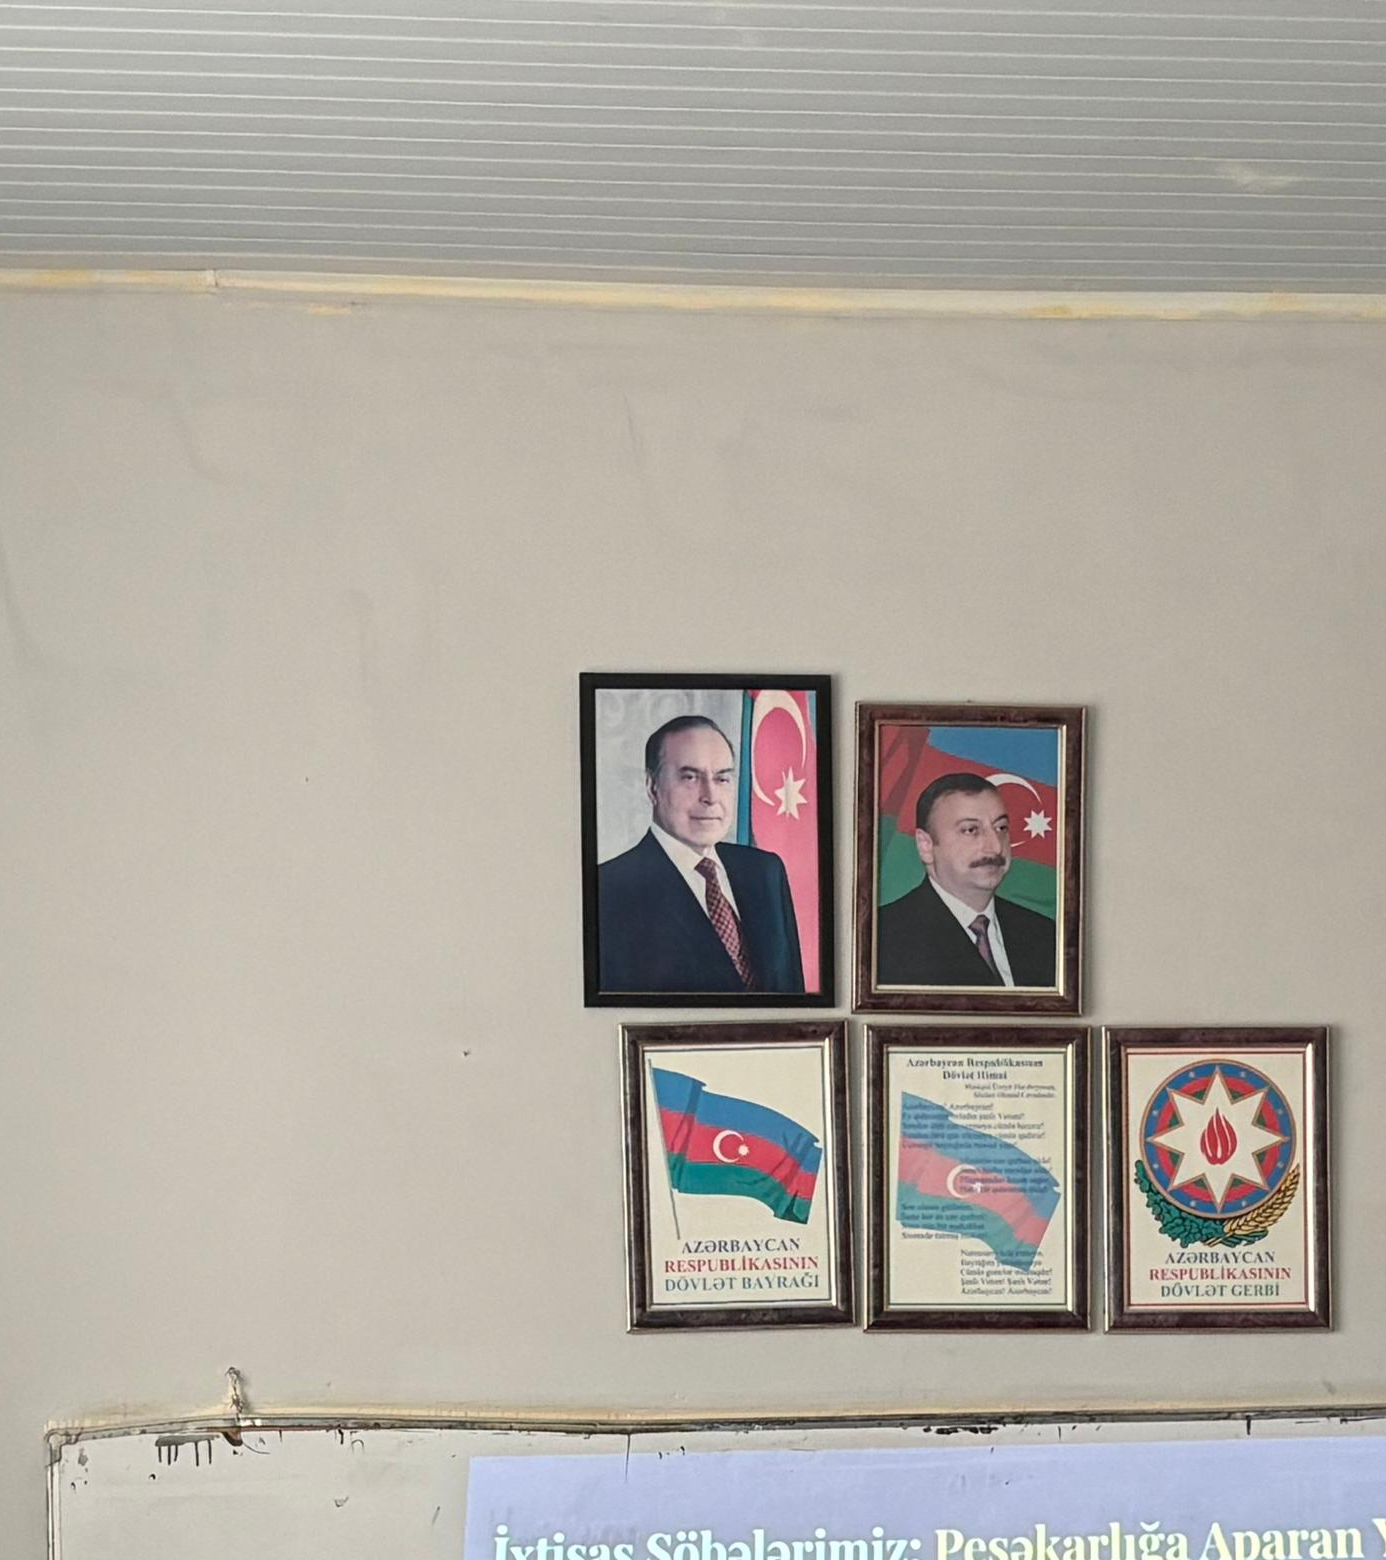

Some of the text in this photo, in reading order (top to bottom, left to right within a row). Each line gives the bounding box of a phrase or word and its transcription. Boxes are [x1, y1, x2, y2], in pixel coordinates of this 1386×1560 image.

[682, 1238, 800, 1254] AZƏRBAYCAN
[665, 1255, 819, 1273] RESPUBLİKASININ
[1165, 1251, 1275, 1264] AZƏRBAYCAN
[1149, 1265, 1291, 1281] RESPUBLİKASININ
[665, 1272, 819, 1292] DÖVLƏT BAYRAĞI
[1161, 1283, 1280, 1298] DÖVLƏT GERBİ
